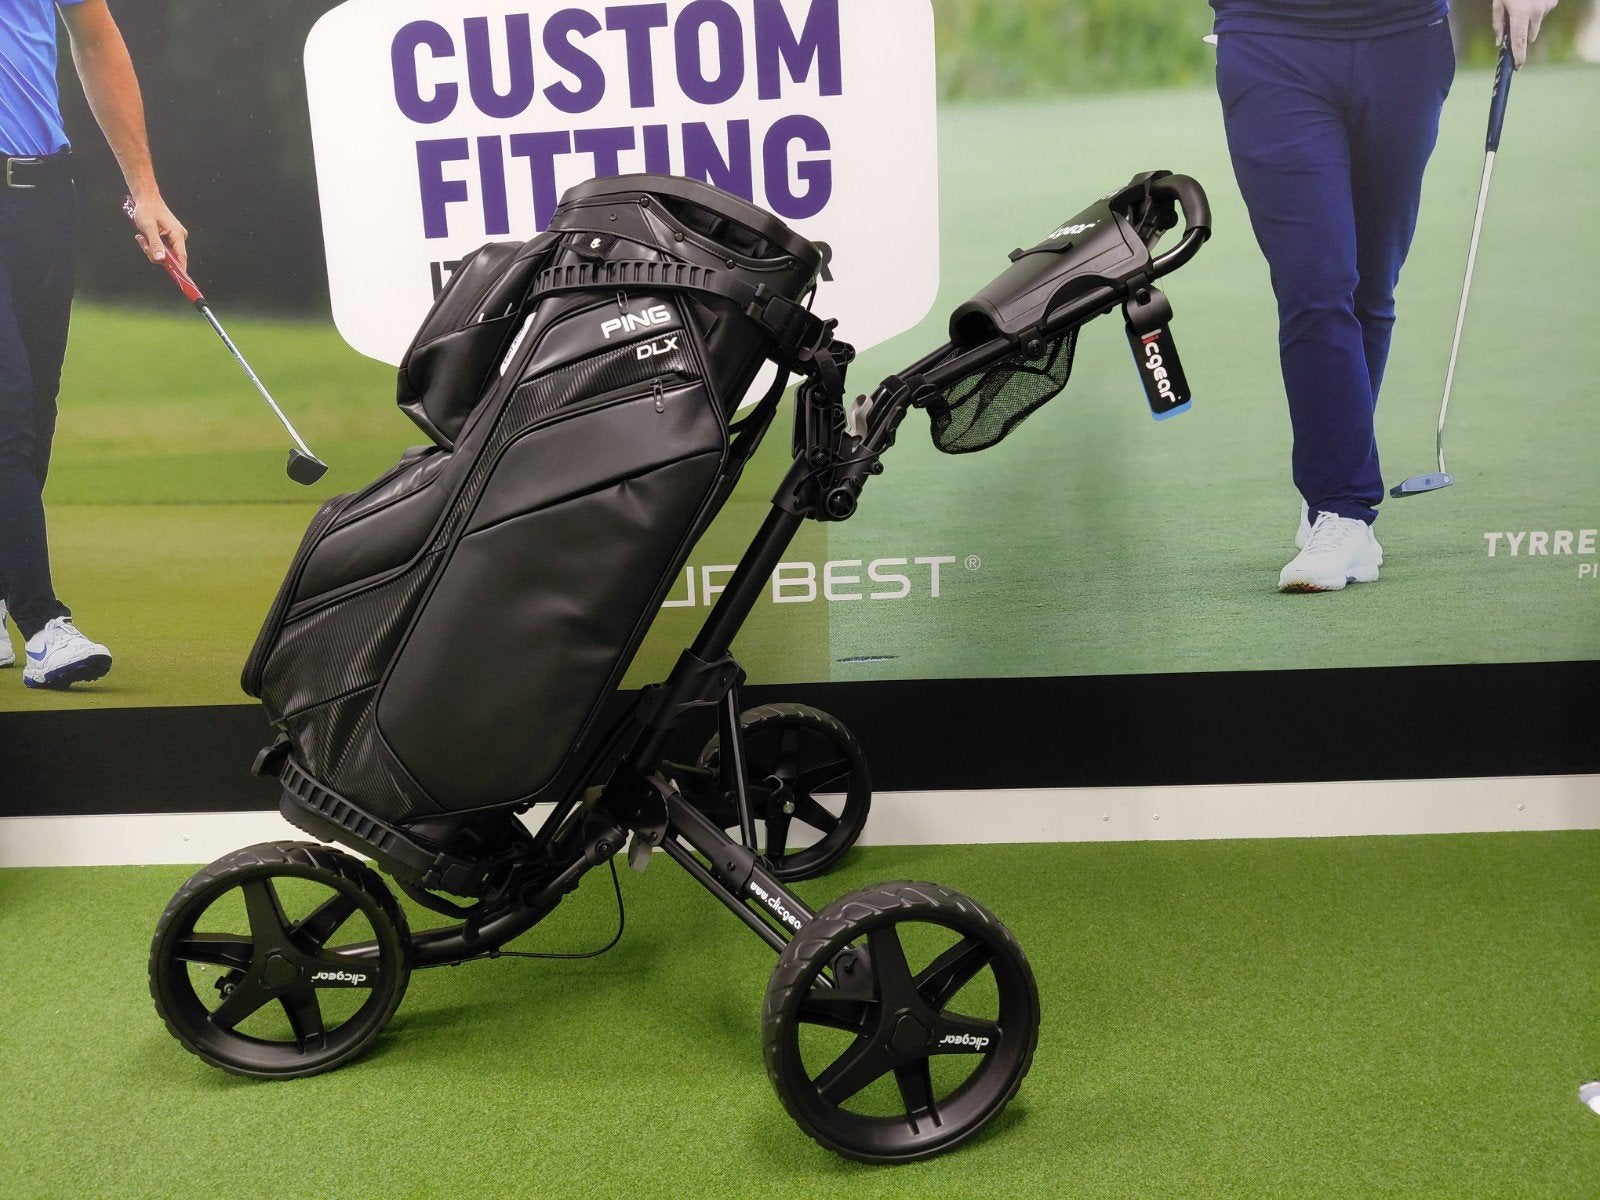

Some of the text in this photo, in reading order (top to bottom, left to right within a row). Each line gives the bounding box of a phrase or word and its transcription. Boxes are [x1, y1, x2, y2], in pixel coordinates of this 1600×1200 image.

[391, 0, 843, 124] CUSTOM
[415, 114, 832, 239] FITTING
[601, 305, 671, 339] PING
[636, 337, 679, 360] DLX
[1484, 529, 1598, 557] TYRRE
[772, 556, 956, 604] BEST
[750, 881, 802, 930] www.clicgea
[312, 971, 367, 986] clicgear
[940, 1033, 990, 1051] clicgear
